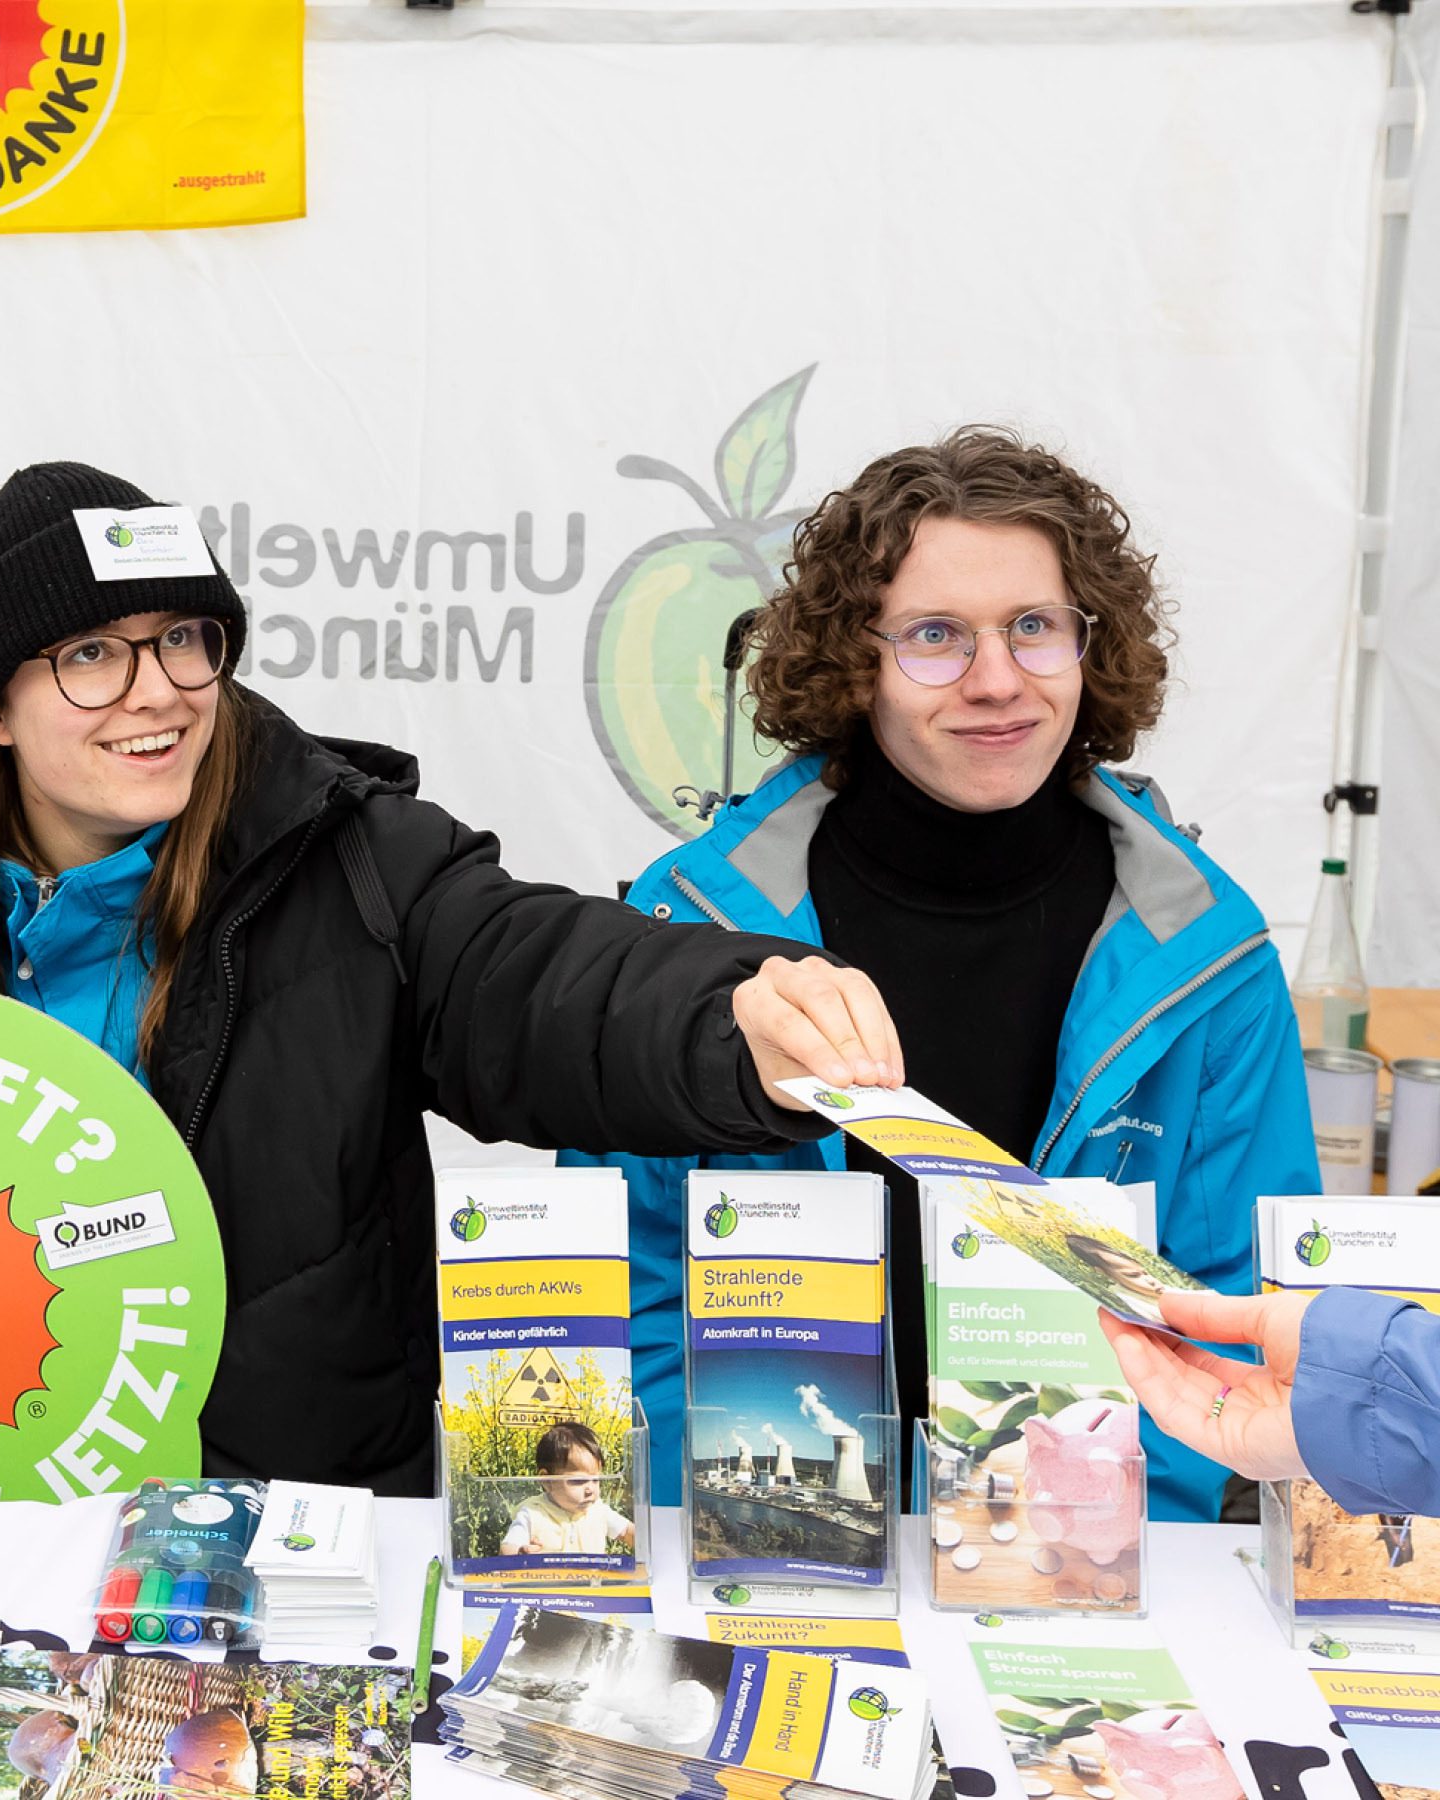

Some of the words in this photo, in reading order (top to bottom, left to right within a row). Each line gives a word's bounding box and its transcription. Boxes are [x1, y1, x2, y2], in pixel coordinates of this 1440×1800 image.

[172, 170, 266, 191] .ausgestrahlt
[482, 1204, 549, 1213] Umweltinstitut
[735, 1202, 801, 1211] Umweltinstitut
[83, 1212, 146, 1241] BUND
[1328, 1230, 1397, 1240] Umweltinstitut
[703, 1268, 803, 1286] Strahlende
[452, 1284, 492, 1299] Krebs
[495, 1282, 535, 1297] durch
[538, 1280, 583, 1295] AKWs
[703, 1290, 784, 1309] Zukunft?
[947, 1302, 1026, 1321] Einfach
[453, 1330, 487, 1342] Kinder
[487, 1327, 516, 1340] leben
[517, 1325, 568, 1340] gefährlich
[703, 1326, 759, 1340] Atomkraft
[761, 1326, 773, 1338] in
[775, 1326, 820, 1342] Europa
[947, 1325, 1010, 1343] Strom
[1015, 1331, 1088, 1347] sparen
[34, 1286, 192, 1503] JETZT!
[145, 1528, 230, 1542] Schneider
[520, 1570, 561, 1580] durch
[566, 1572, 608, 1580] AKWs
[474, 1595, 509, 1604] Kinder
[511, 1597, 540, 1605] leben
[543, 1598, 594, 1608] gefährlich
[718, 1618, 827, 1630] Strahlende
[720, 1630, 809, 1641] Zukunft?
[984, 1649, 1067, 1665] Einfach
[988, 1663, 1056, 1677] Strom
[1061, 1668, 1137, 1680] sparen
[785, 1670, 808, 1709] Hand
[267, 1703, 295, 1742] Wild
[782, 1711, 802, 1726] in
[334, 1705, 353, 1763] gegessen
[775, 1723, 799, 1753] Hand
[267, 1747, 292, 1782] und
[329, 1765, 349, 1799] nicht
